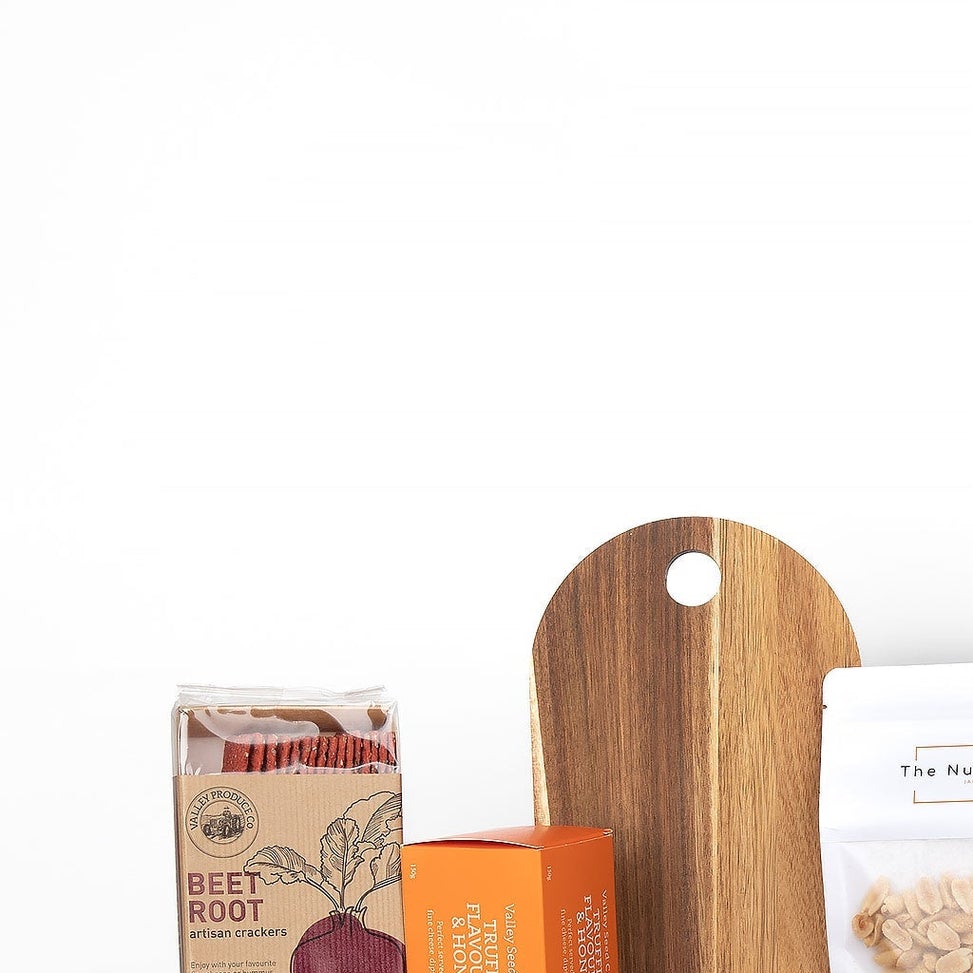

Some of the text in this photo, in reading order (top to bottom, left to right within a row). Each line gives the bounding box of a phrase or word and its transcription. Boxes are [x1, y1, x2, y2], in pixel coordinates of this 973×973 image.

[901, 765, 936, 777] The
[190, 790, 253, 831] VALLEY PRODUCE
[187, 872, 261, 896] BEET
[188, 899, 264, 923] ROOT
[451, 916, 466, 929] &
[189, 927, 288, 939] artisan crackers
[436, 920, 444, 951] Perfect
[503, 903, 516, 945] Valley
